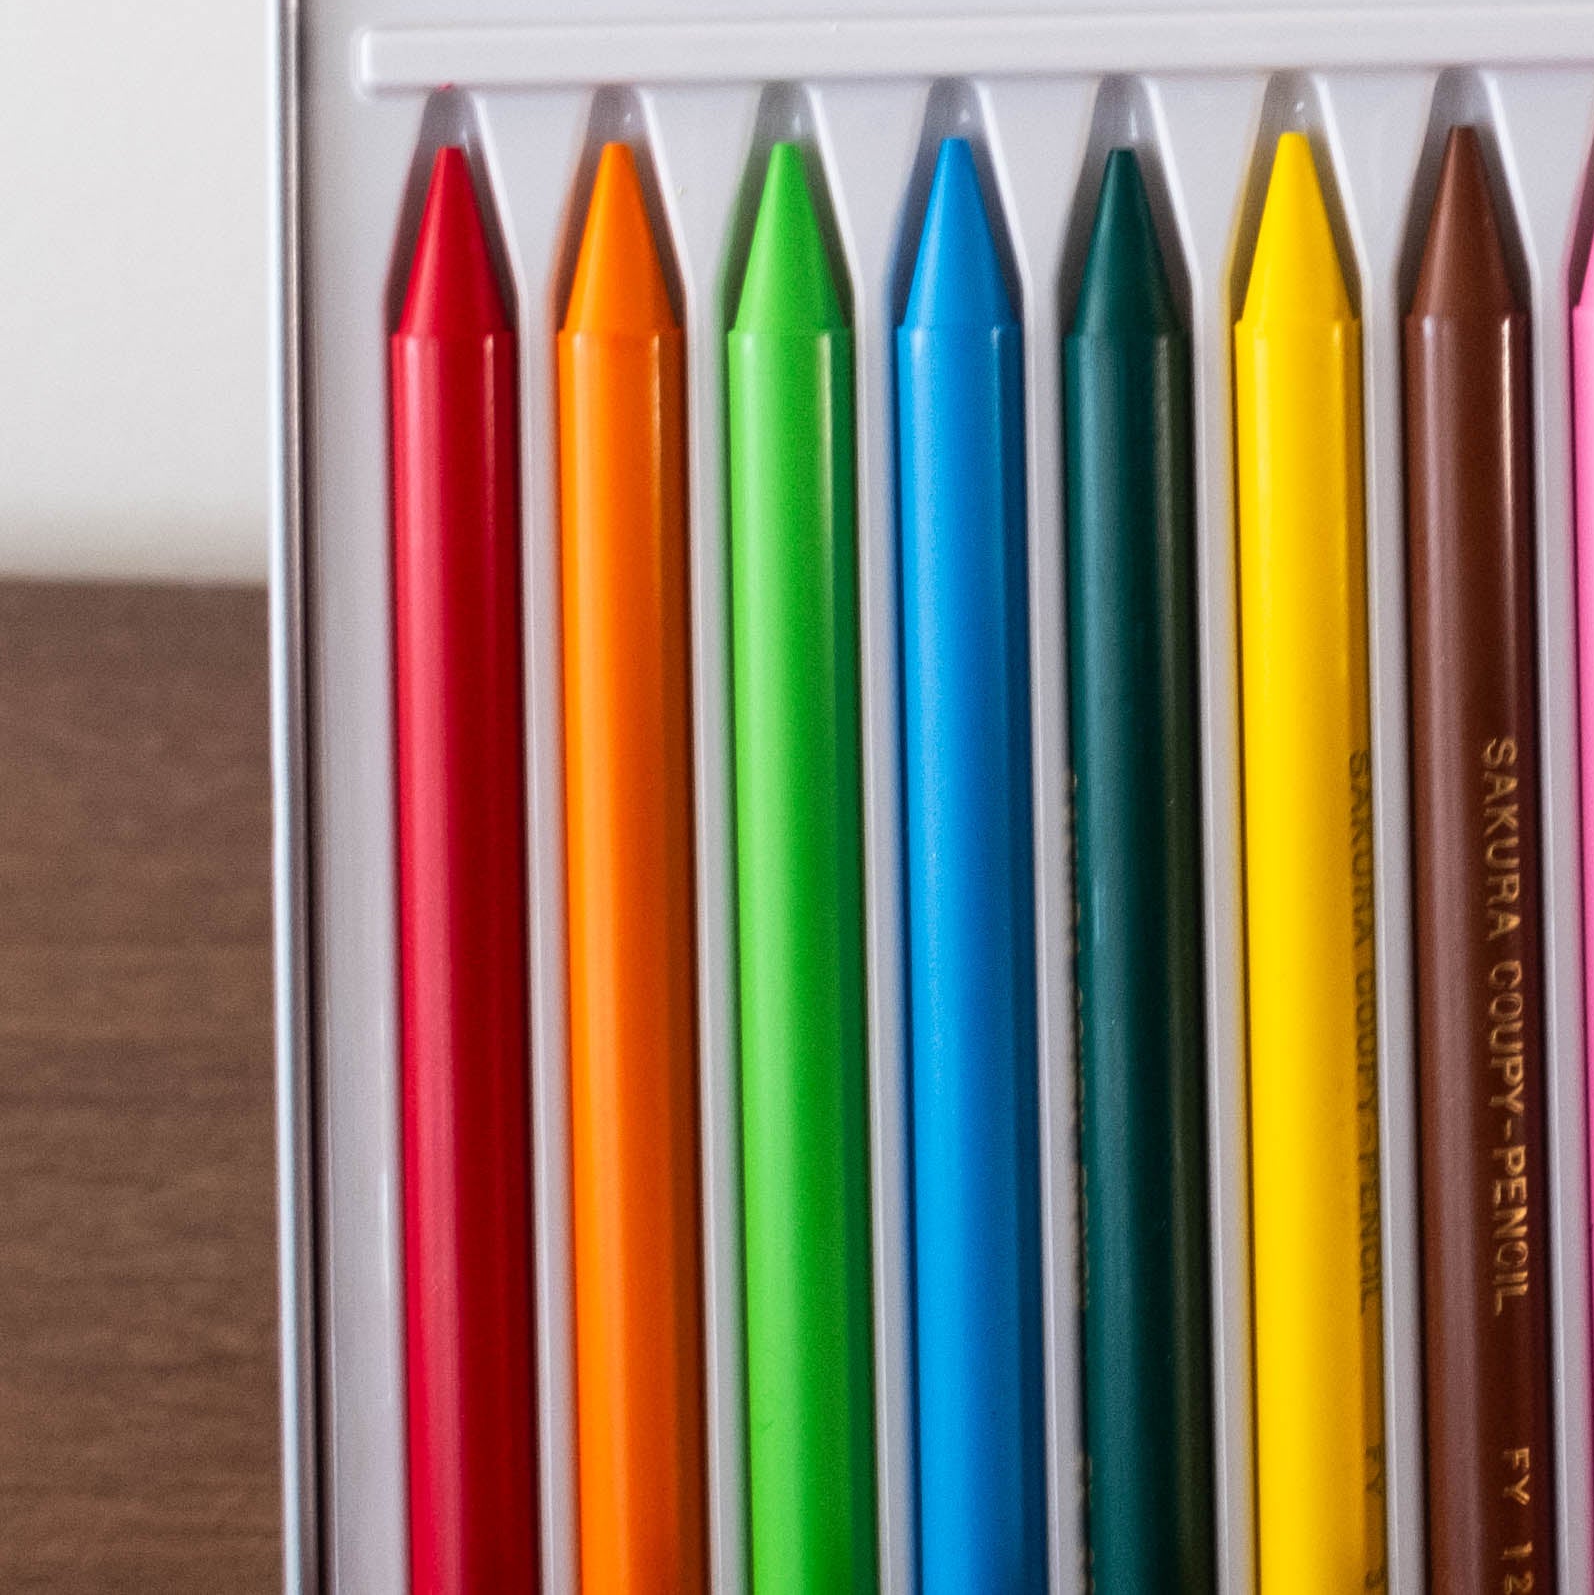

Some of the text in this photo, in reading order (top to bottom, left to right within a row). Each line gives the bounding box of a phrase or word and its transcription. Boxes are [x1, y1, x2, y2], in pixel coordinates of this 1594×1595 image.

[1482, 737, 1534, 1595] SAKURA COUPY-PENCIL FY 12
